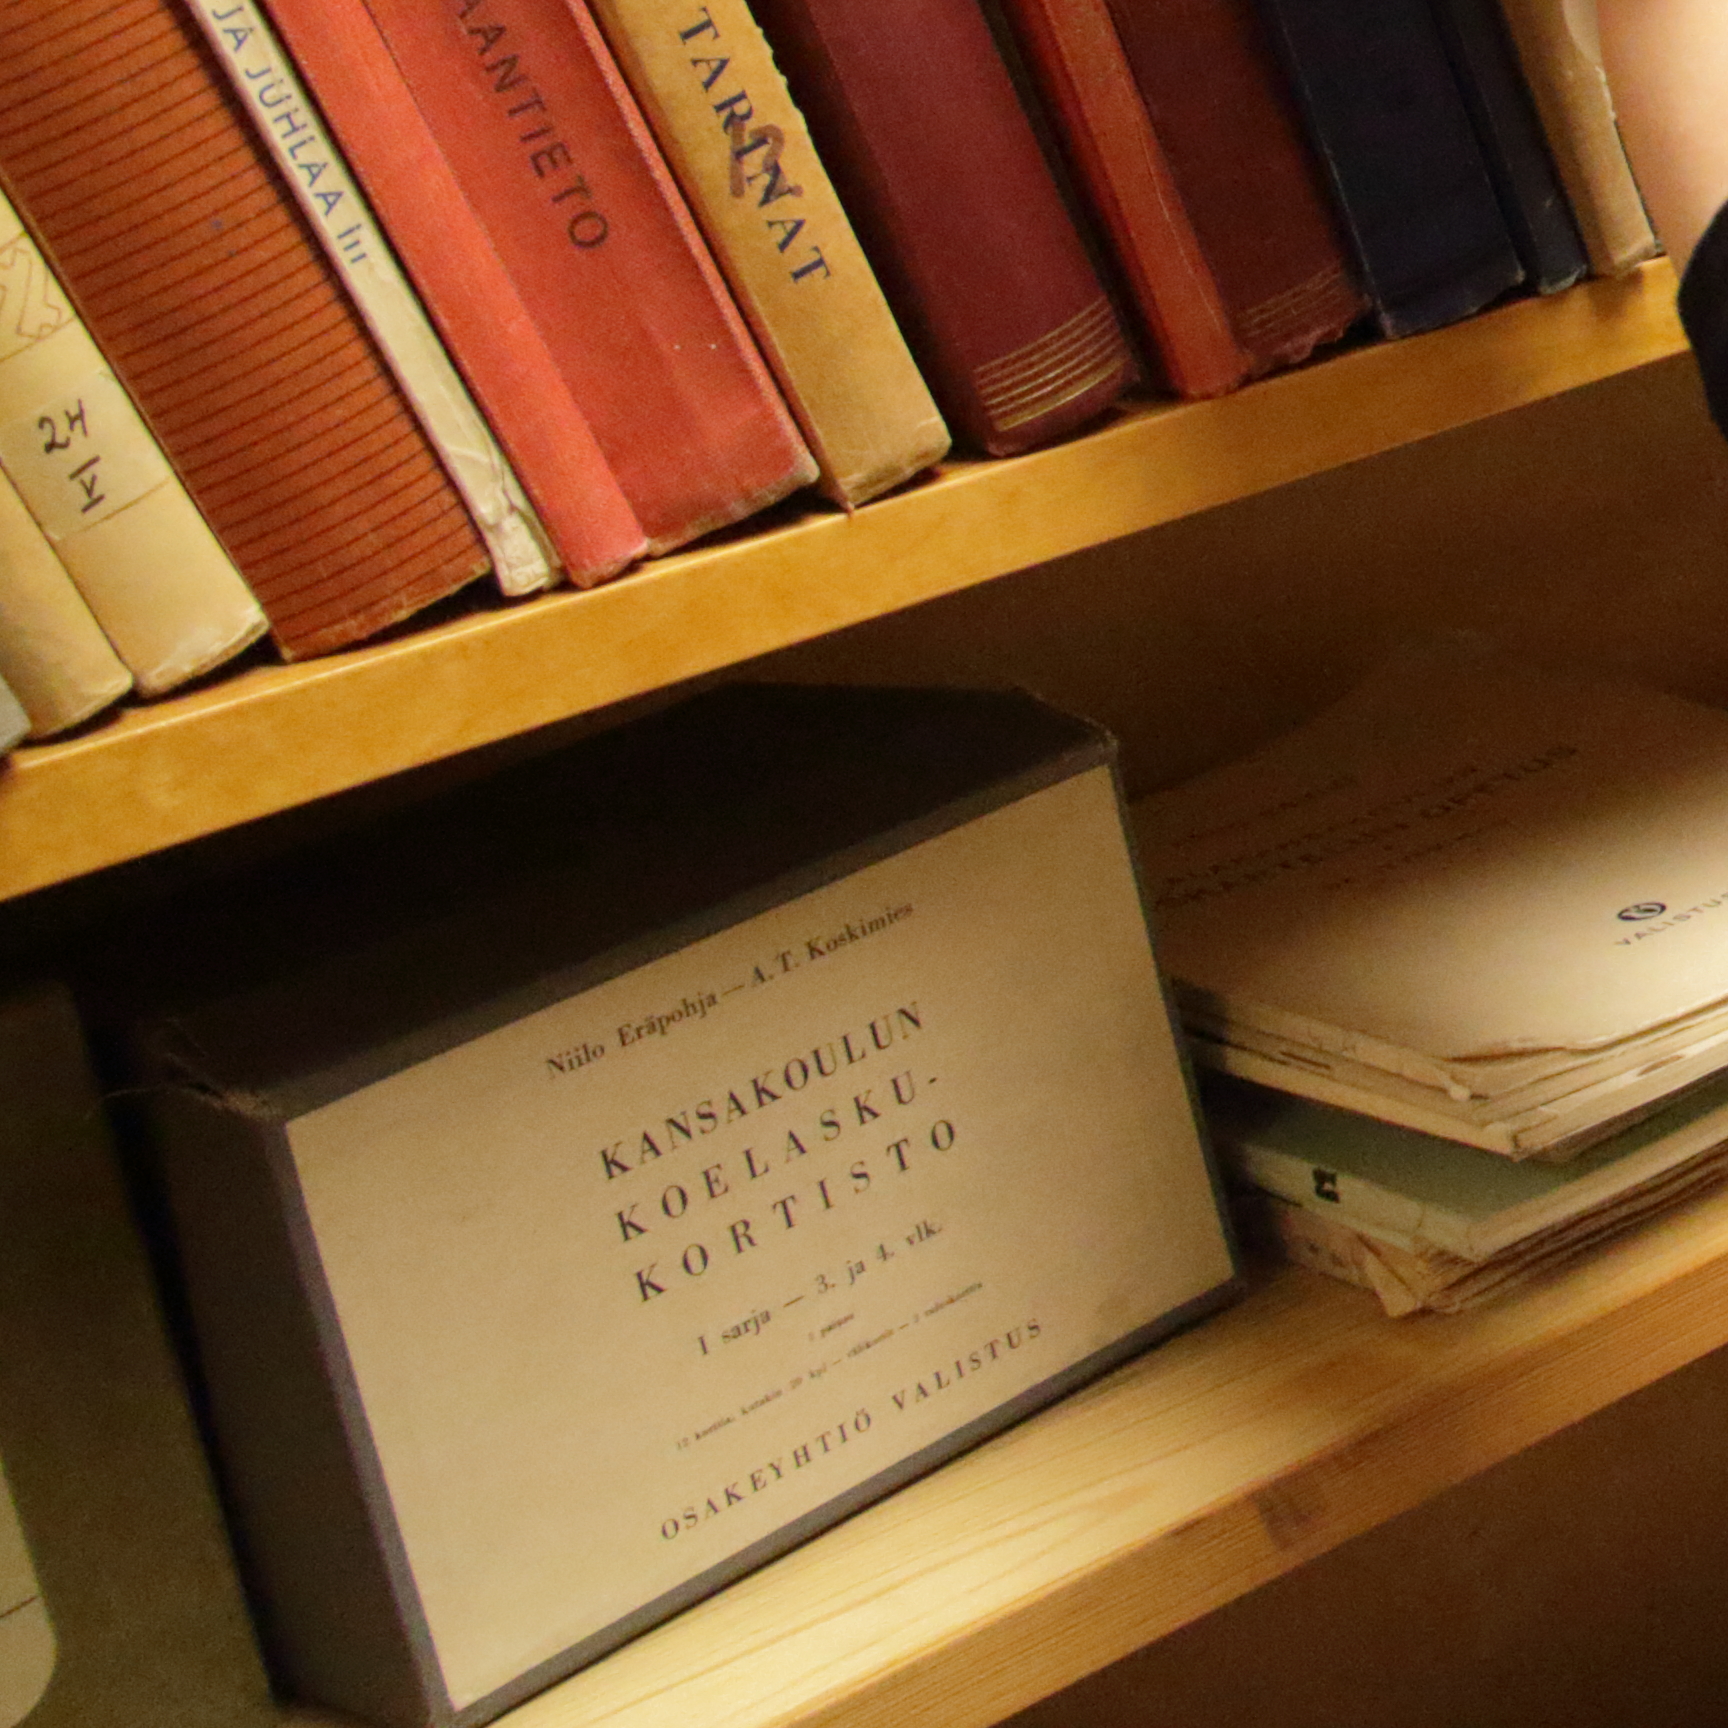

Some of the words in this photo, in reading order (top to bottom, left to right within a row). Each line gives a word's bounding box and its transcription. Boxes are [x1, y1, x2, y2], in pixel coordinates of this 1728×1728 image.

[211, 4, 256, 52] JA
[244, 67, 345, 216] JUHLAA
[679, 6, 831, 284] TARINAT
[546, 1043, 606, 1080] Niilo
[617, 991, 718, 1049] Eräpohja
[751, 965, 775, 988] A.
[804, 900, 915, 962] Koskimies
[600, 1001, 924, 1180] KANSAKOULUN
[615, 1071, 937, 1242] KOELASKU-
[636, 1119, 956, 1303] KORTISTO
[721, 1309, 772, 1345] sarja
[846, 1259, 867, 1285] ja
[905, 1219, 944, 1248] vlk.
[660, 1408, 873, 1541] OSAKEYHTIÖ
[891, 1317, 1042, 1411] VALISTUS
